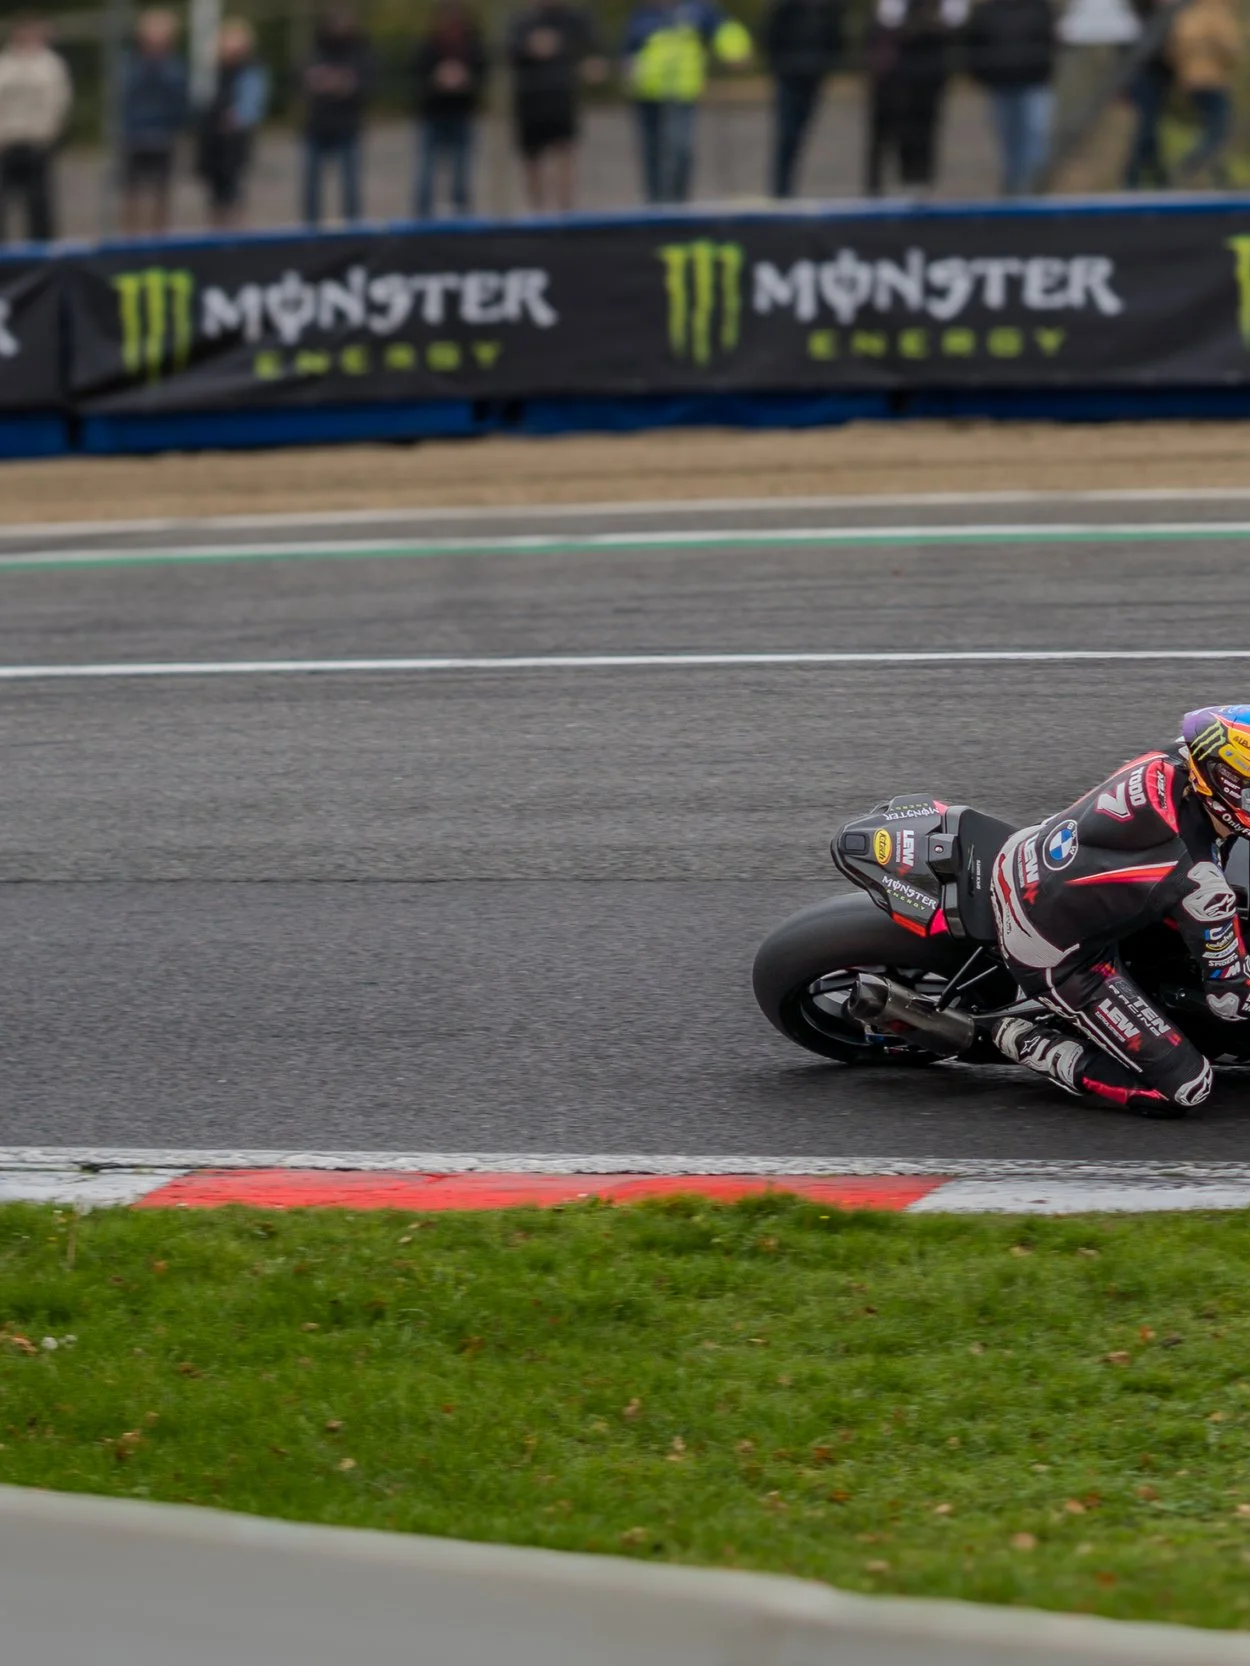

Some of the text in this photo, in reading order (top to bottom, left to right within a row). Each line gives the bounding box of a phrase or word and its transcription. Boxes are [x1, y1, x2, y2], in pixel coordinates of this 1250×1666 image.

[752, 248, 1123, 321] MONSTER
[200, 266, 559, 345] MONSTER
[254, 341, 502, 378] ENERGY
[808, 326, 1067, 361] ENERGY
[1096, 782, 1132, 819] 7
[1128, 766, 1147, 807] TODD
[883, 806, 940, 821] MONSTER
[902, 829, 915, 867] LEW
[882, 875, 938, 910] MONSTER
[1098, 998, 1140, 1038] LEW
[1108, 985, 1161, 1037] RACING
